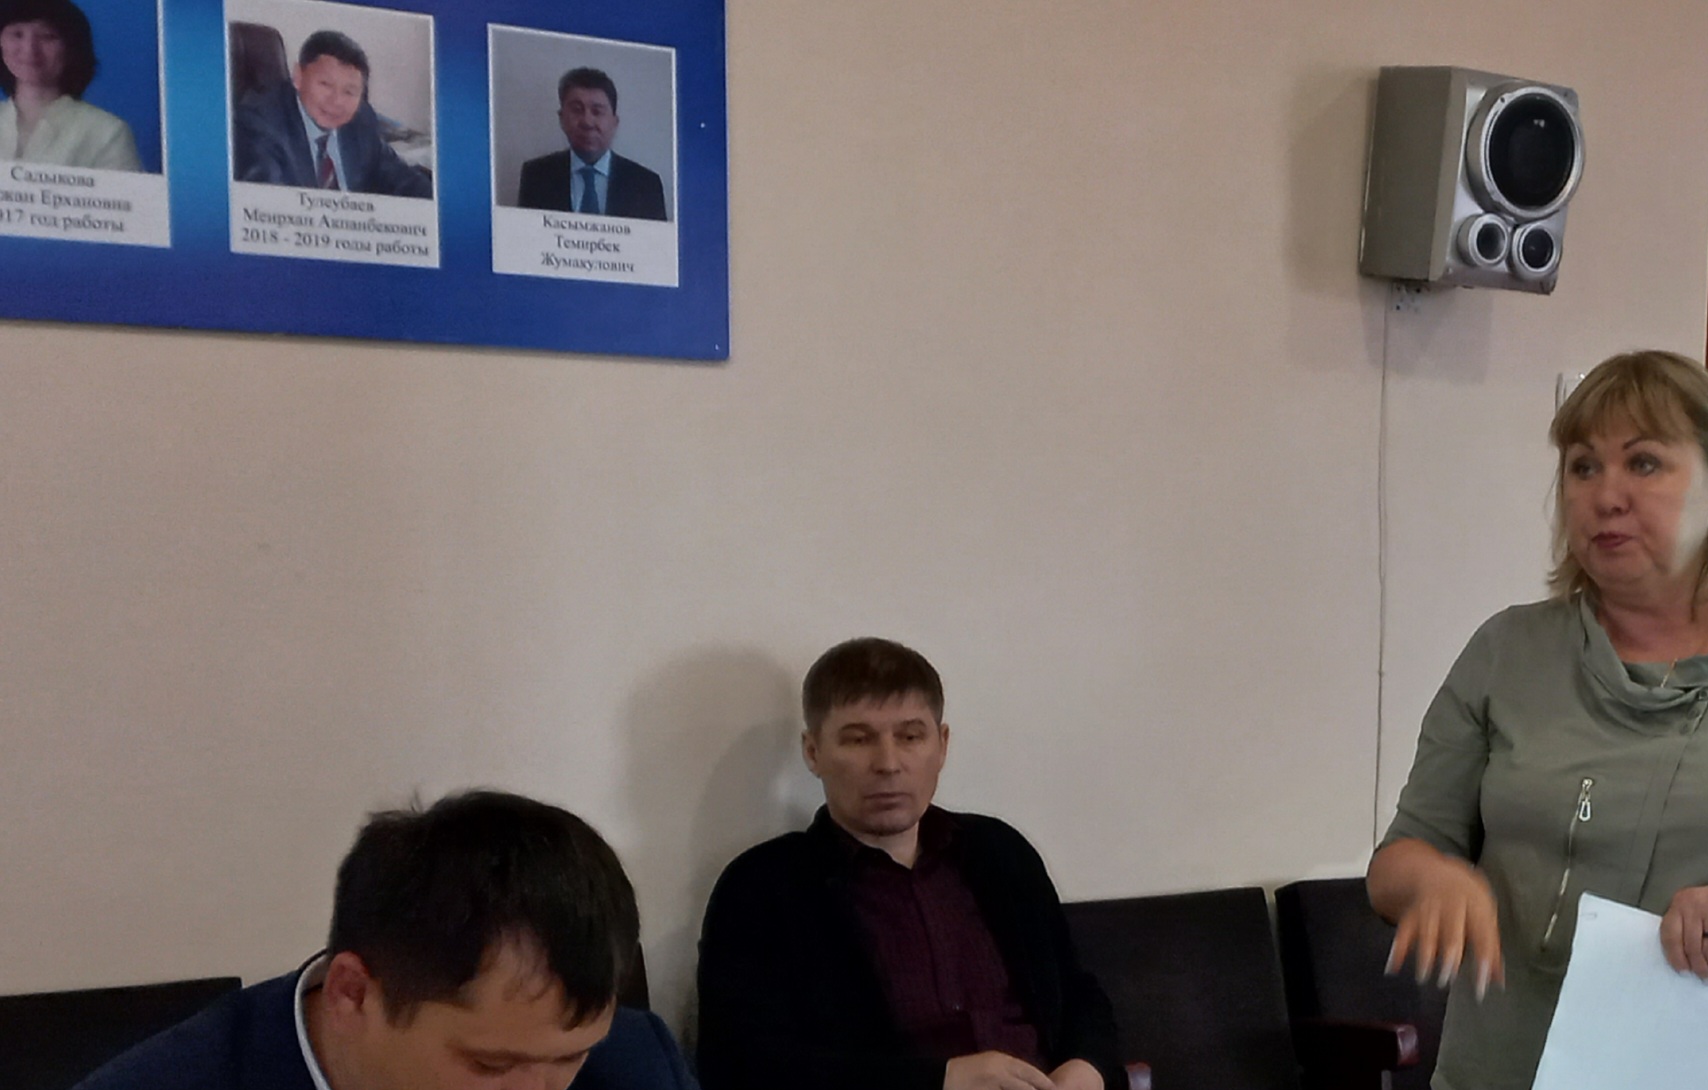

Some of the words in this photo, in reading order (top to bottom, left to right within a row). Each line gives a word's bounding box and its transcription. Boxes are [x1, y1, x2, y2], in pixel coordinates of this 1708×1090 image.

[11, 166, 95, 187] Садыкова
[30, 213, 57, 227] год
[62, 213, 124, 232] работы
[543, 215, 631, 235] Касымжанов
[242, 227, 278, 244] 2018
[294, 232, 330, 249] 2019
[335, 239, 371, 254] годы
[376, 241, 430, 257] работы
[555, 235, 621, 253] Темирбек
